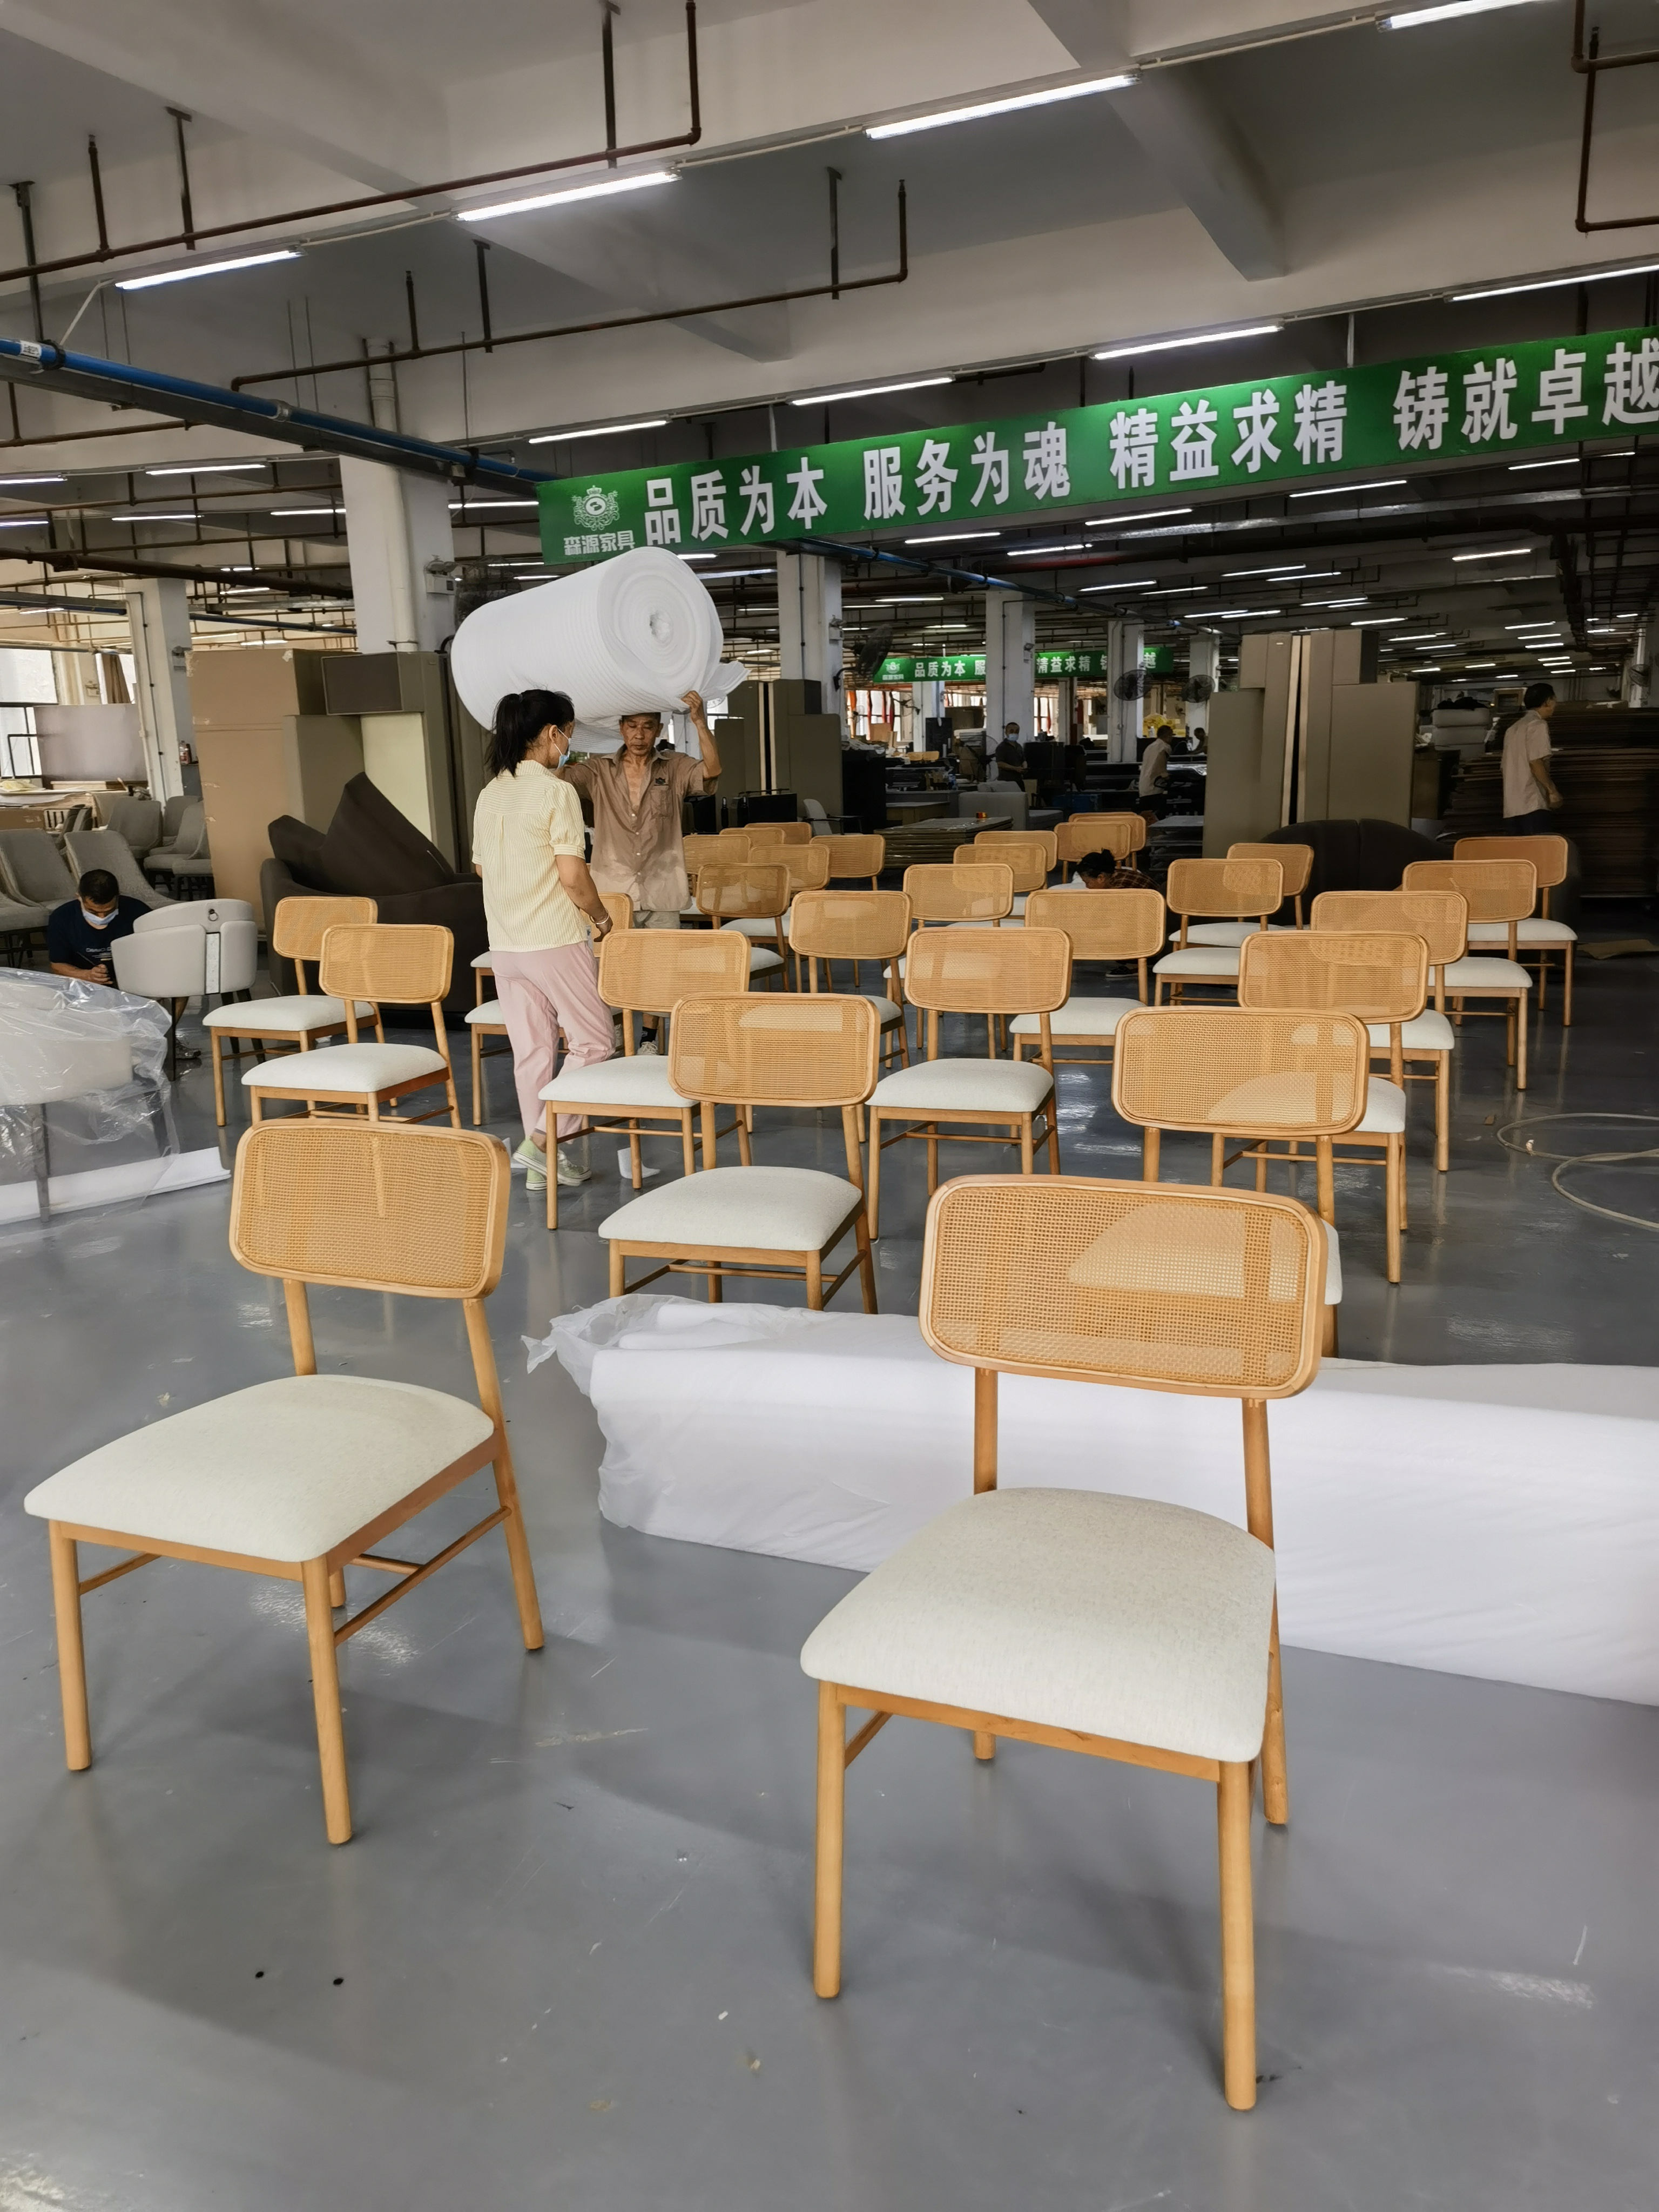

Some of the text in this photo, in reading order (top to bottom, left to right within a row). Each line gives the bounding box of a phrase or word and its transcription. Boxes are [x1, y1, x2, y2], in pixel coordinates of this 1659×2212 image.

[644, 338, 1659, 546] 品质为本 服务为魂 精益求精 铸就卓越
[563, 530, 636, 556] 森源家具
[914, 660, 966, 678] 品质为本
